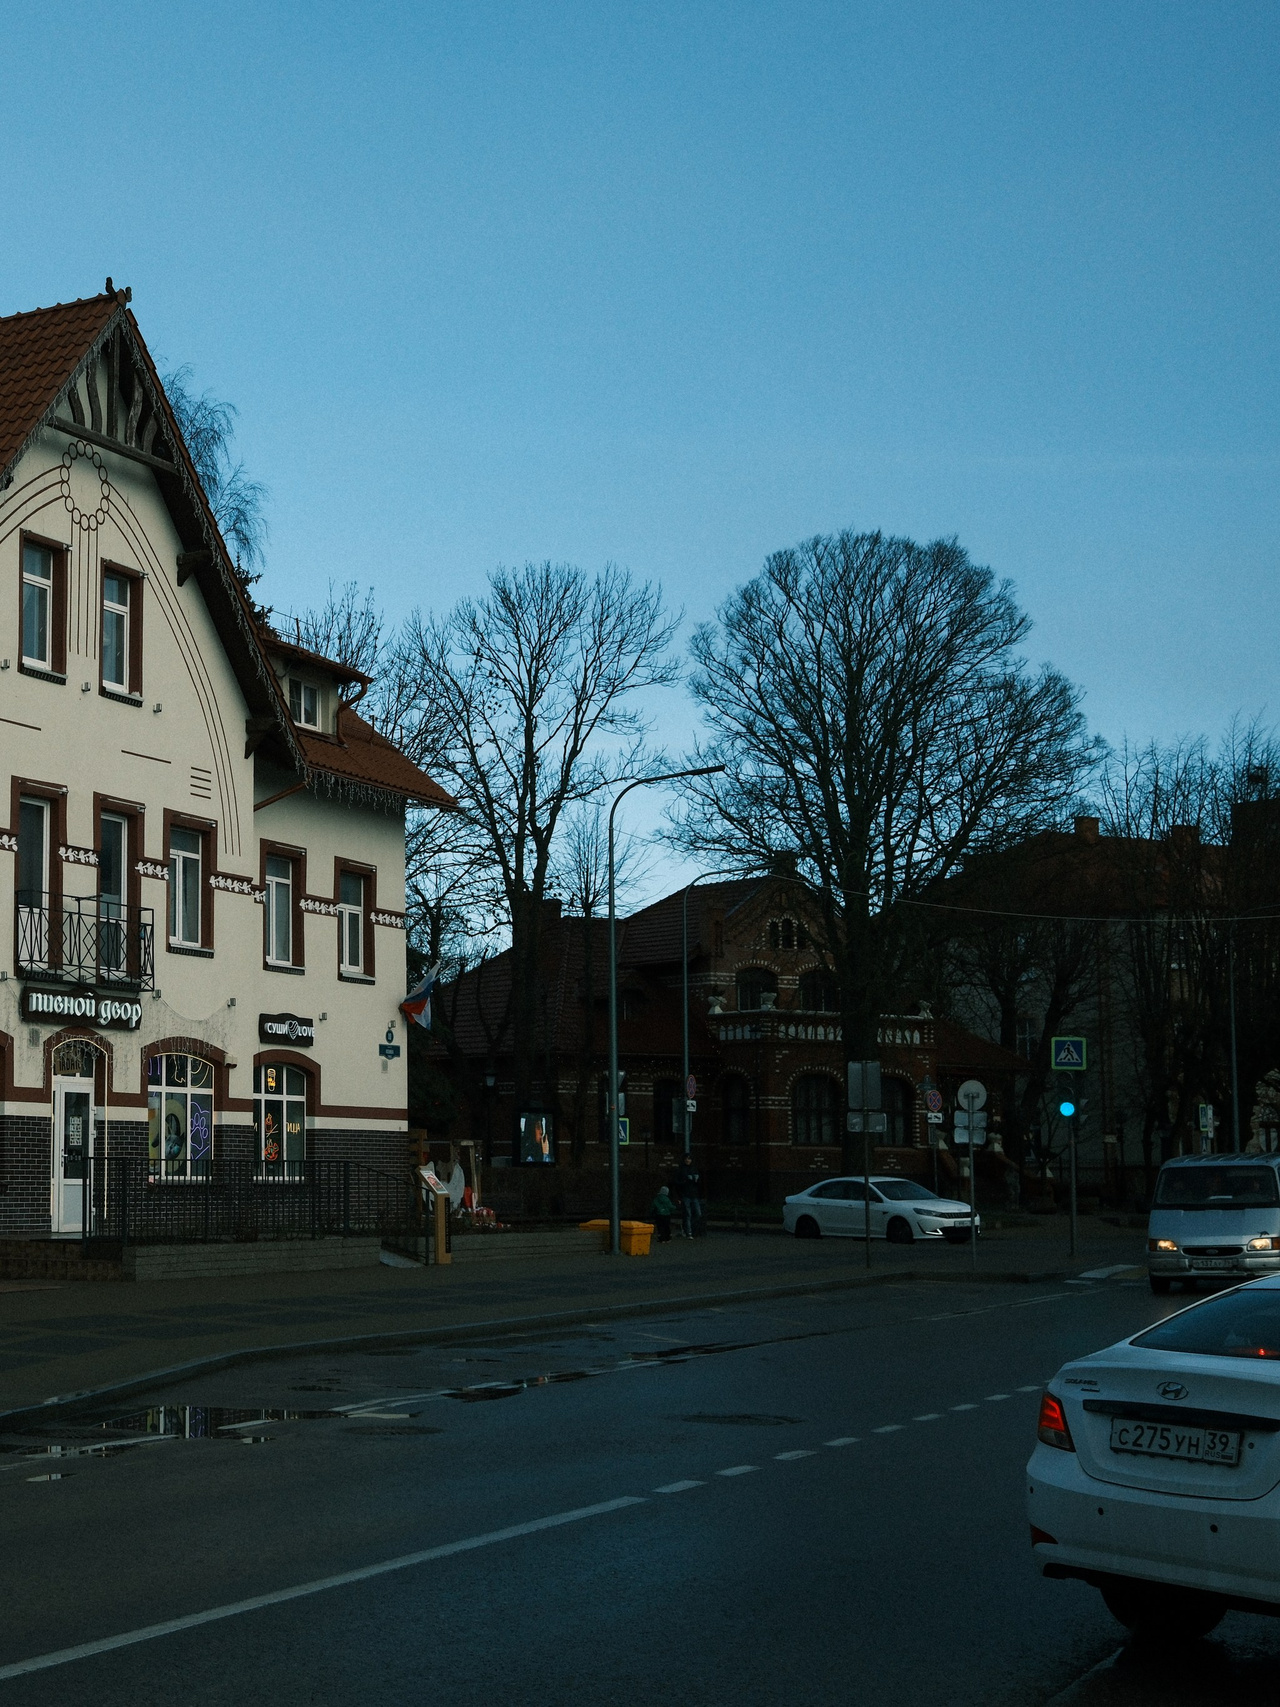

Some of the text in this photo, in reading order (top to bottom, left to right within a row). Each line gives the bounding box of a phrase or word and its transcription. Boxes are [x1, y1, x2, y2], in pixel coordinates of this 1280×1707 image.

[267, 1022, 315, 1037] СУШИ LOVE
[1207, 1432, 1230, 1452] 39
[1205, 1450, 1220, 1459] RUS
